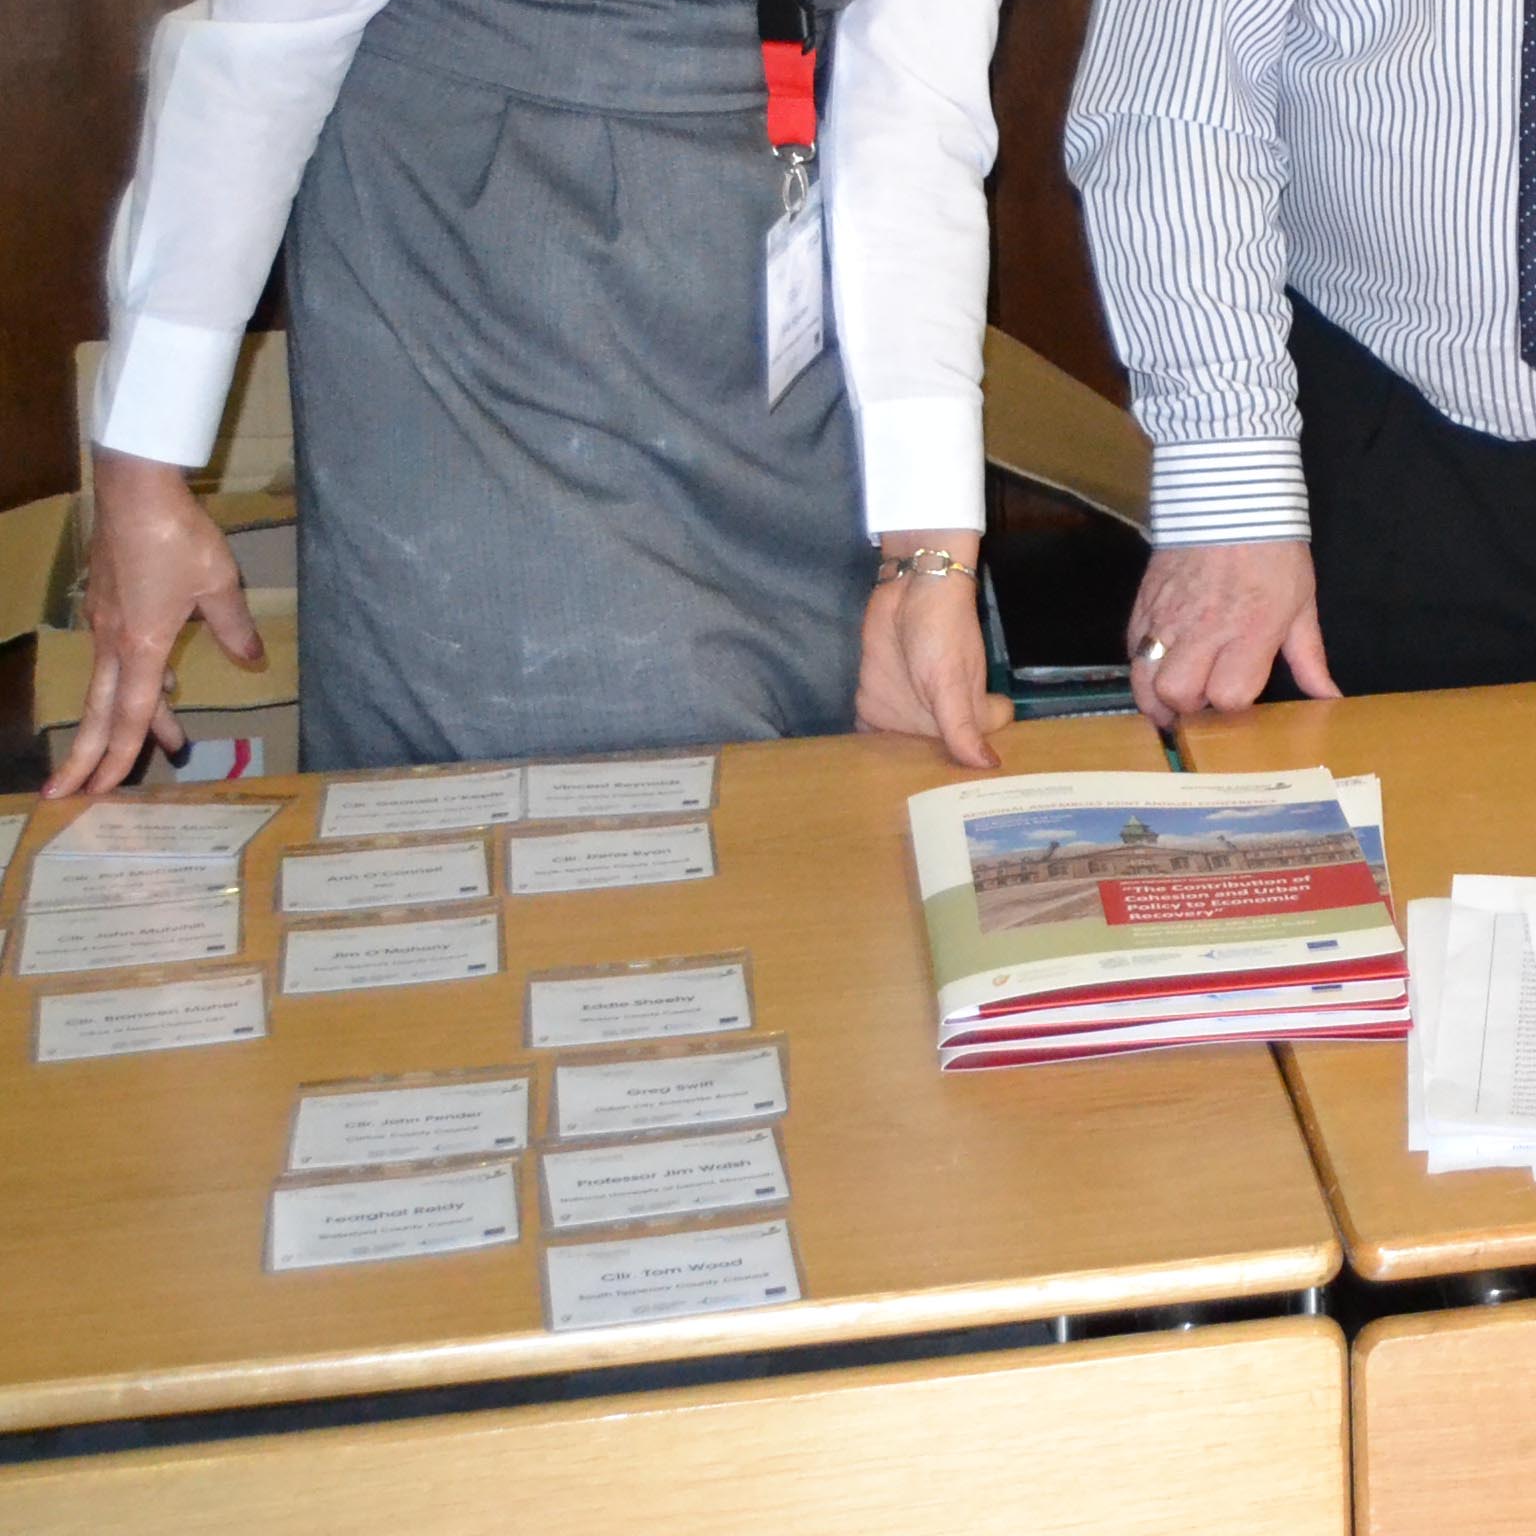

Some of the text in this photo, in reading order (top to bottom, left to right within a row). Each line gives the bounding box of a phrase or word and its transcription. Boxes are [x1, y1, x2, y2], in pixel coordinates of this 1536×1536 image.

[1171, 877, 1288, 892] Contribution
[1293, 875, 1312, 883] of
[1124, 884, 1311, 903] Cohesion and Urban
[1126, 902, 1181, 912] Policy
[1210, 894, 1300, 906] Economic
[626, 1085, 672, 1098] Greg
[380, 1116, 421, 1127] John
[577, 1160, 752, 1187] Professor Jim Walsh
[641, 1267, 682, 1278] Tom
[688, 1258, 744, 1271] Wood
